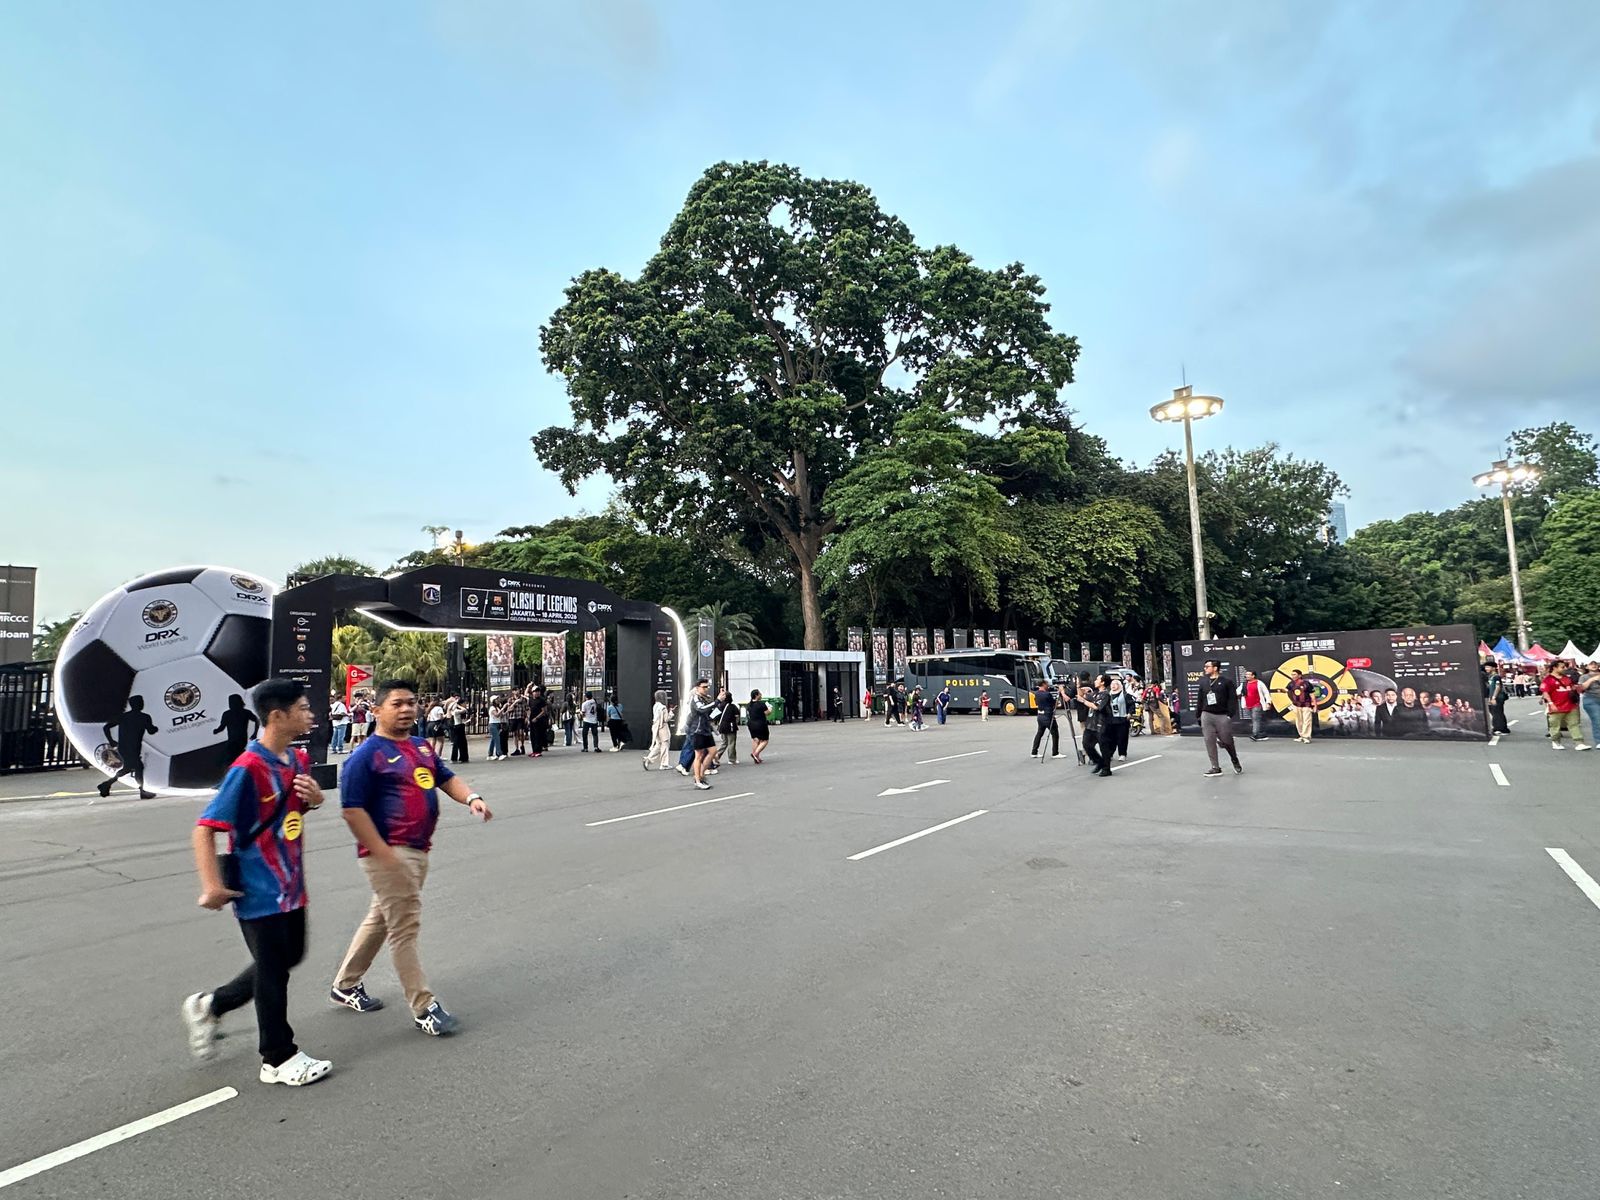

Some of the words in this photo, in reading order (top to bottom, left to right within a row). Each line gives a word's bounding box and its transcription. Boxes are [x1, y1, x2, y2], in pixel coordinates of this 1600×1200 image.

[236, 592, 268, 603] DRX
[510, 591, 535, 610] CLASH
[536, 593, 546, 611] OF
[547, 594, 578, 613] LEGENDS
[510, 609, 535, 617] JAKARTA
[145, 627, 180, 642] DRX
[350, 669, 358, 678] G
[945, 679, 979, 687] POLISI
[590, 705, 595, 716] 4
[172, 710, 206, 726] DRX
